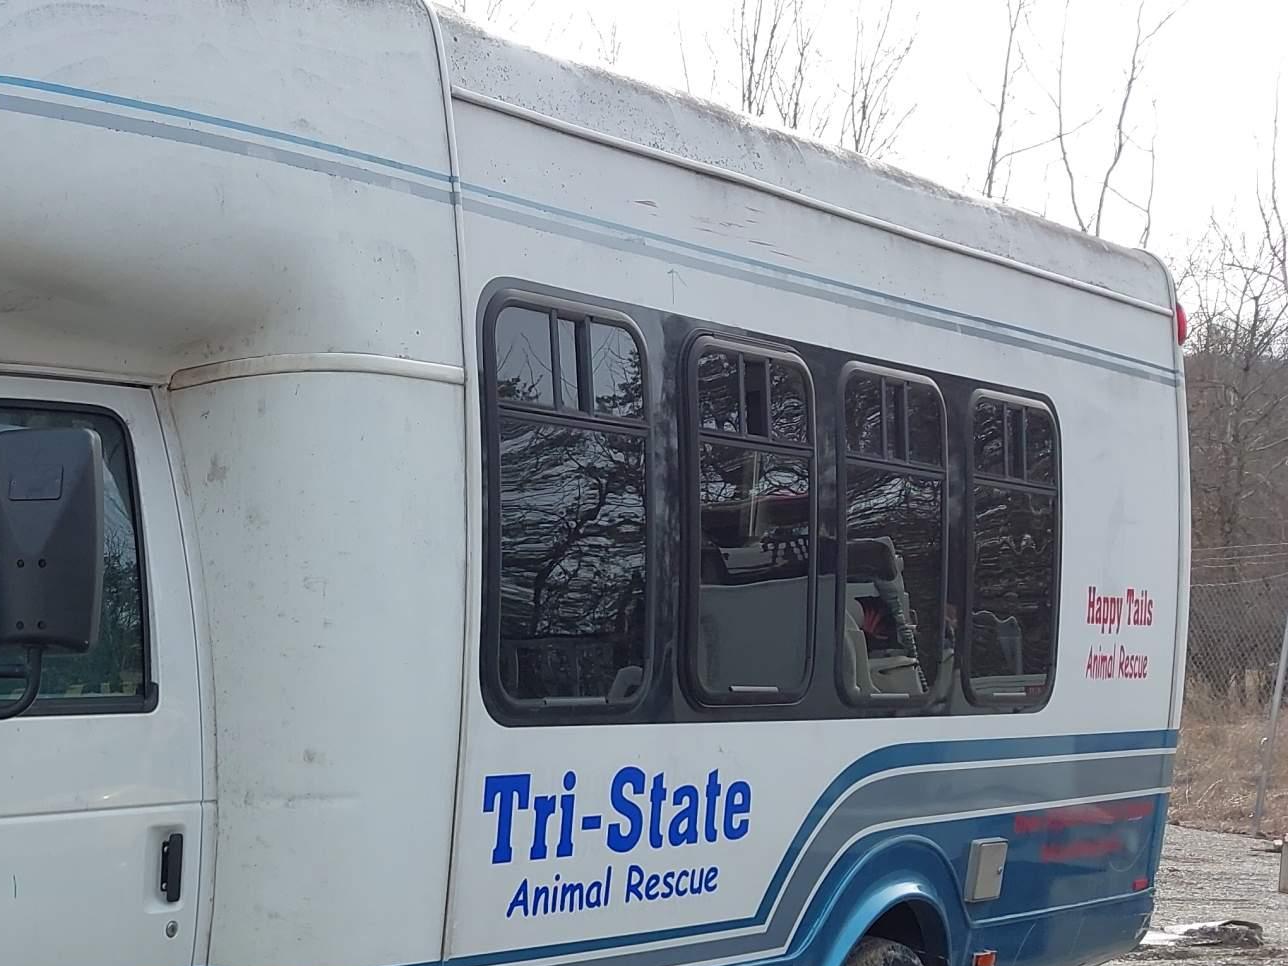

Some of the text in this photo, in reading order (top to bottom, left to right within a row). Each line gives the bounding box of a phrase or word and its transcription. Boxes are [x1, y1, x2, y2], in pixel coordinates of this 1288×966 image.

[1086, 586, 1154, 634] Happy Tails
[1086, 645, 1148, 681] Animal Rescue
[483, 766, 752, 865] Tri-State
[506, 864, 719, 918] Animal Rescue
